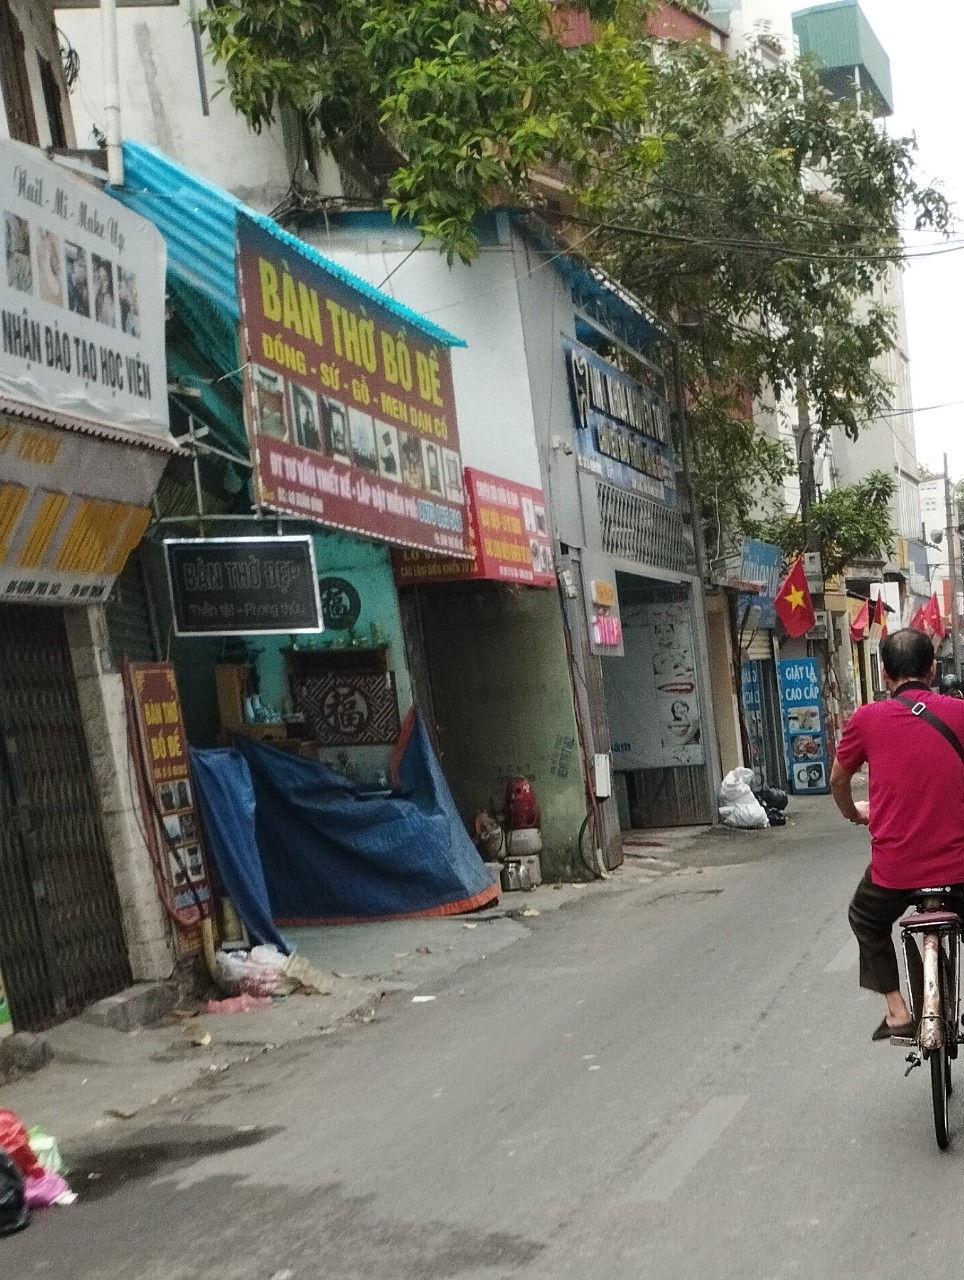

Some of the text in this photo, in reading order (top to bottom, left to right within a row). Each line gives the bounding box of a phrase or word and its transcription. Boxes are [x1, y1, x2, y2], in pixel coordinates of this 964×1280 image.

[259, 257, 323, 347] BÀN
[326, 304, 377, 374] THỜ
[381, 326, 412, 392] BỒ
[1, 308, 151, 400] NHẬN ĐÀO TẠO HỌC VIÊN
[785, 666, 803, 682] GIẶT
[786, 683, 819, 701] CAO CẤP
